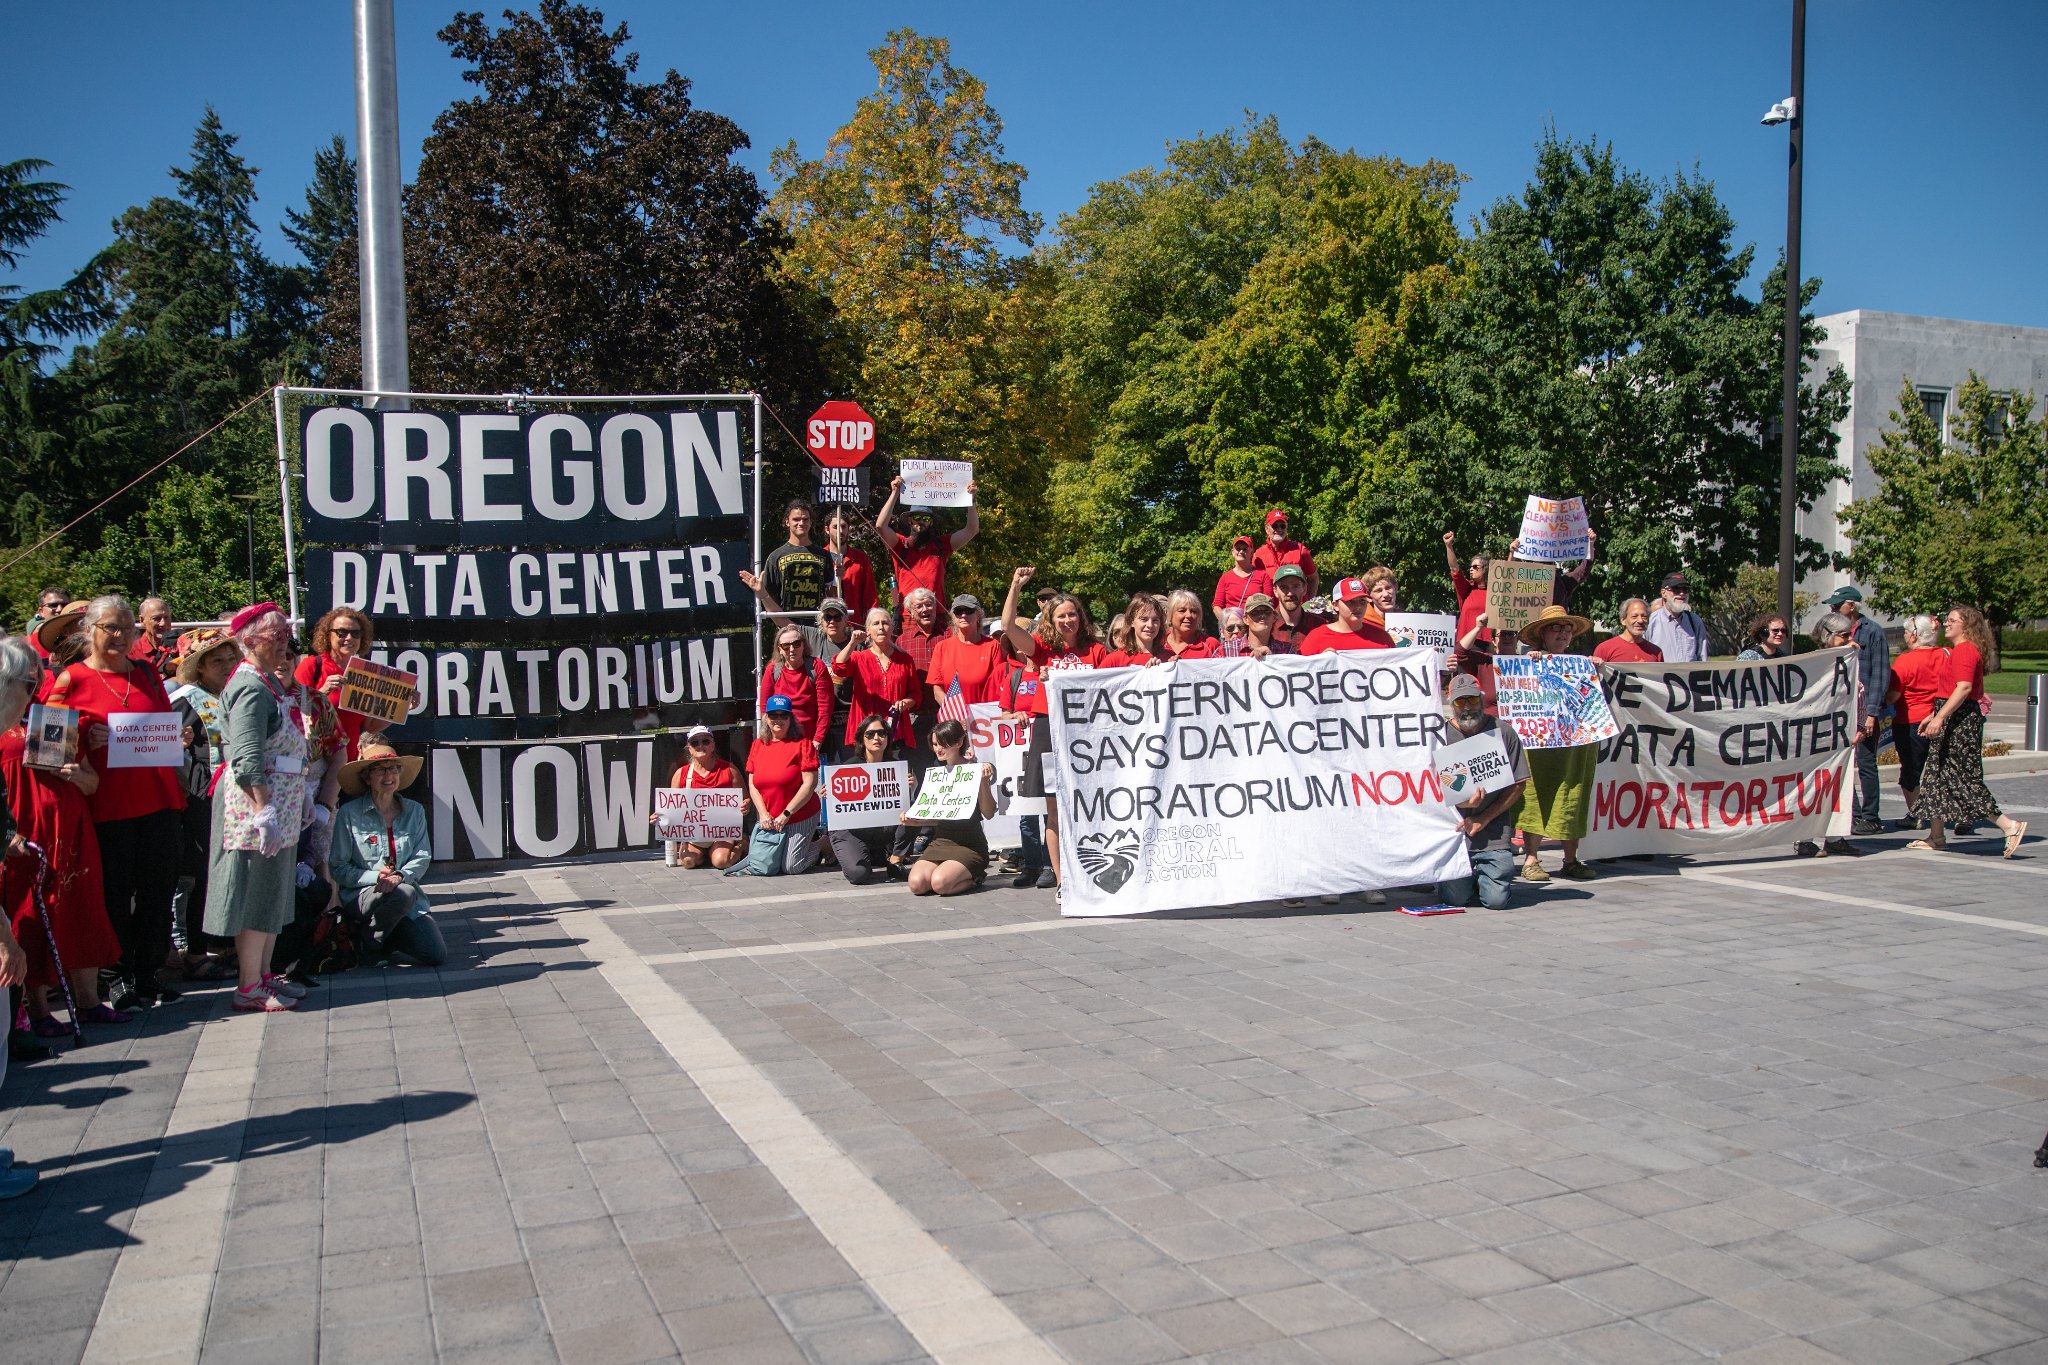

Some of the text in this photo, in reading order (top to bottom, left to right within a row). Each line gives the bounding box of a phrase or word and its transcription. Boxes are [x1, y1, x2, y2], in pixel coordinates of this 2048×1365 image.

[809, 420, 873, 450] STOP
[306, 407, 744, 522] OREGON
[902, 461, 972, 472] PUBLIC LIBRARIES
[821, 467, 857, 485] DATA
[818, 486, 860, 503] CENTERS
[910, 490, 958, 499] I SUPPORT
[1537, 499, 1580, 513] NEEDS
[1525, 510, 1552, 523] CLEAN
[1548, 522, 1569, 532] VS
[1525, 537, 1557, 547] DRONE
[1518, 544, 1585, 559] SURVEILLANCE
[1494, 565, 1553, 580] OUR RIVERS
[332, 546, 727, 617] DATA CENTER
[790, 579, 818, 593] Cuba
[1492, 581, 1548, 594] OUR FARMS
[793, 594, 816, 608] Live
[1490, 595, 1547, 607] OUR MINDS
[1498, 607, 1528, 618] BELONG
[1504, 618, 1515, 629] TO
[1417, 629, 1448, 637] OREGON
[1417, 636, 1454, 648] RURAL
[364, 661, 401, 679] DATA CENTER
[371, 637, 733, 717] ORATORIUM
[346, 670, 412, 701] MORATORIUM
[1499, 677, 1515, 689] MAY
[1663, 663, 1807, 713] DEMAND
[1831, 656, 1851, 697] A
[1062, 665, 1431, 725] EASTERN OREGON
[347, 689, 398, 719] NOW!
[116, 724, 177, 733] DATA CENTER
[1516, 718, 1556, 736] 2030
[116, 735, 177, 743] MORATORIUM
[1719, 710, 1851, 766] CENTER
[1069, 732, 1170, 774] SAYS
[1467, 750, 1498, 766] OREGON
[1470, 755, 1509, 777] RURAL
[877, 767, 896, 782] DATA
[927, 766, 974, 783] Tech Bros
[1473, 769, 1501, 784] ACTION
[833, 776, 868, 794] STOP
[873, 782, 900, 798] CENTERS
[939, 781, 954, 794] and
[432, 741, 653, 860] NOW
[659, 791, 739, 809] DATA CENTERS
[917, 793, 972, 806] Data Centers
[1073, 773, 1348, 822] MORATORIUM
[1351, 769, 1444, 807] NOW
[1593, 766, 1843, 832] MORATORIUM
[835, 800, 900, 813] STATEWIDE
[915, 807, 931, 818] rob
[683, 810, 708, 823] ARE
[659, 824, 741, 838] WATER THIEVES
[1143, 823, 1221, 843] OREGON
[1144, 837, 1244, 866] RURAL
[1145, 863, 1217, 883] ACTION
